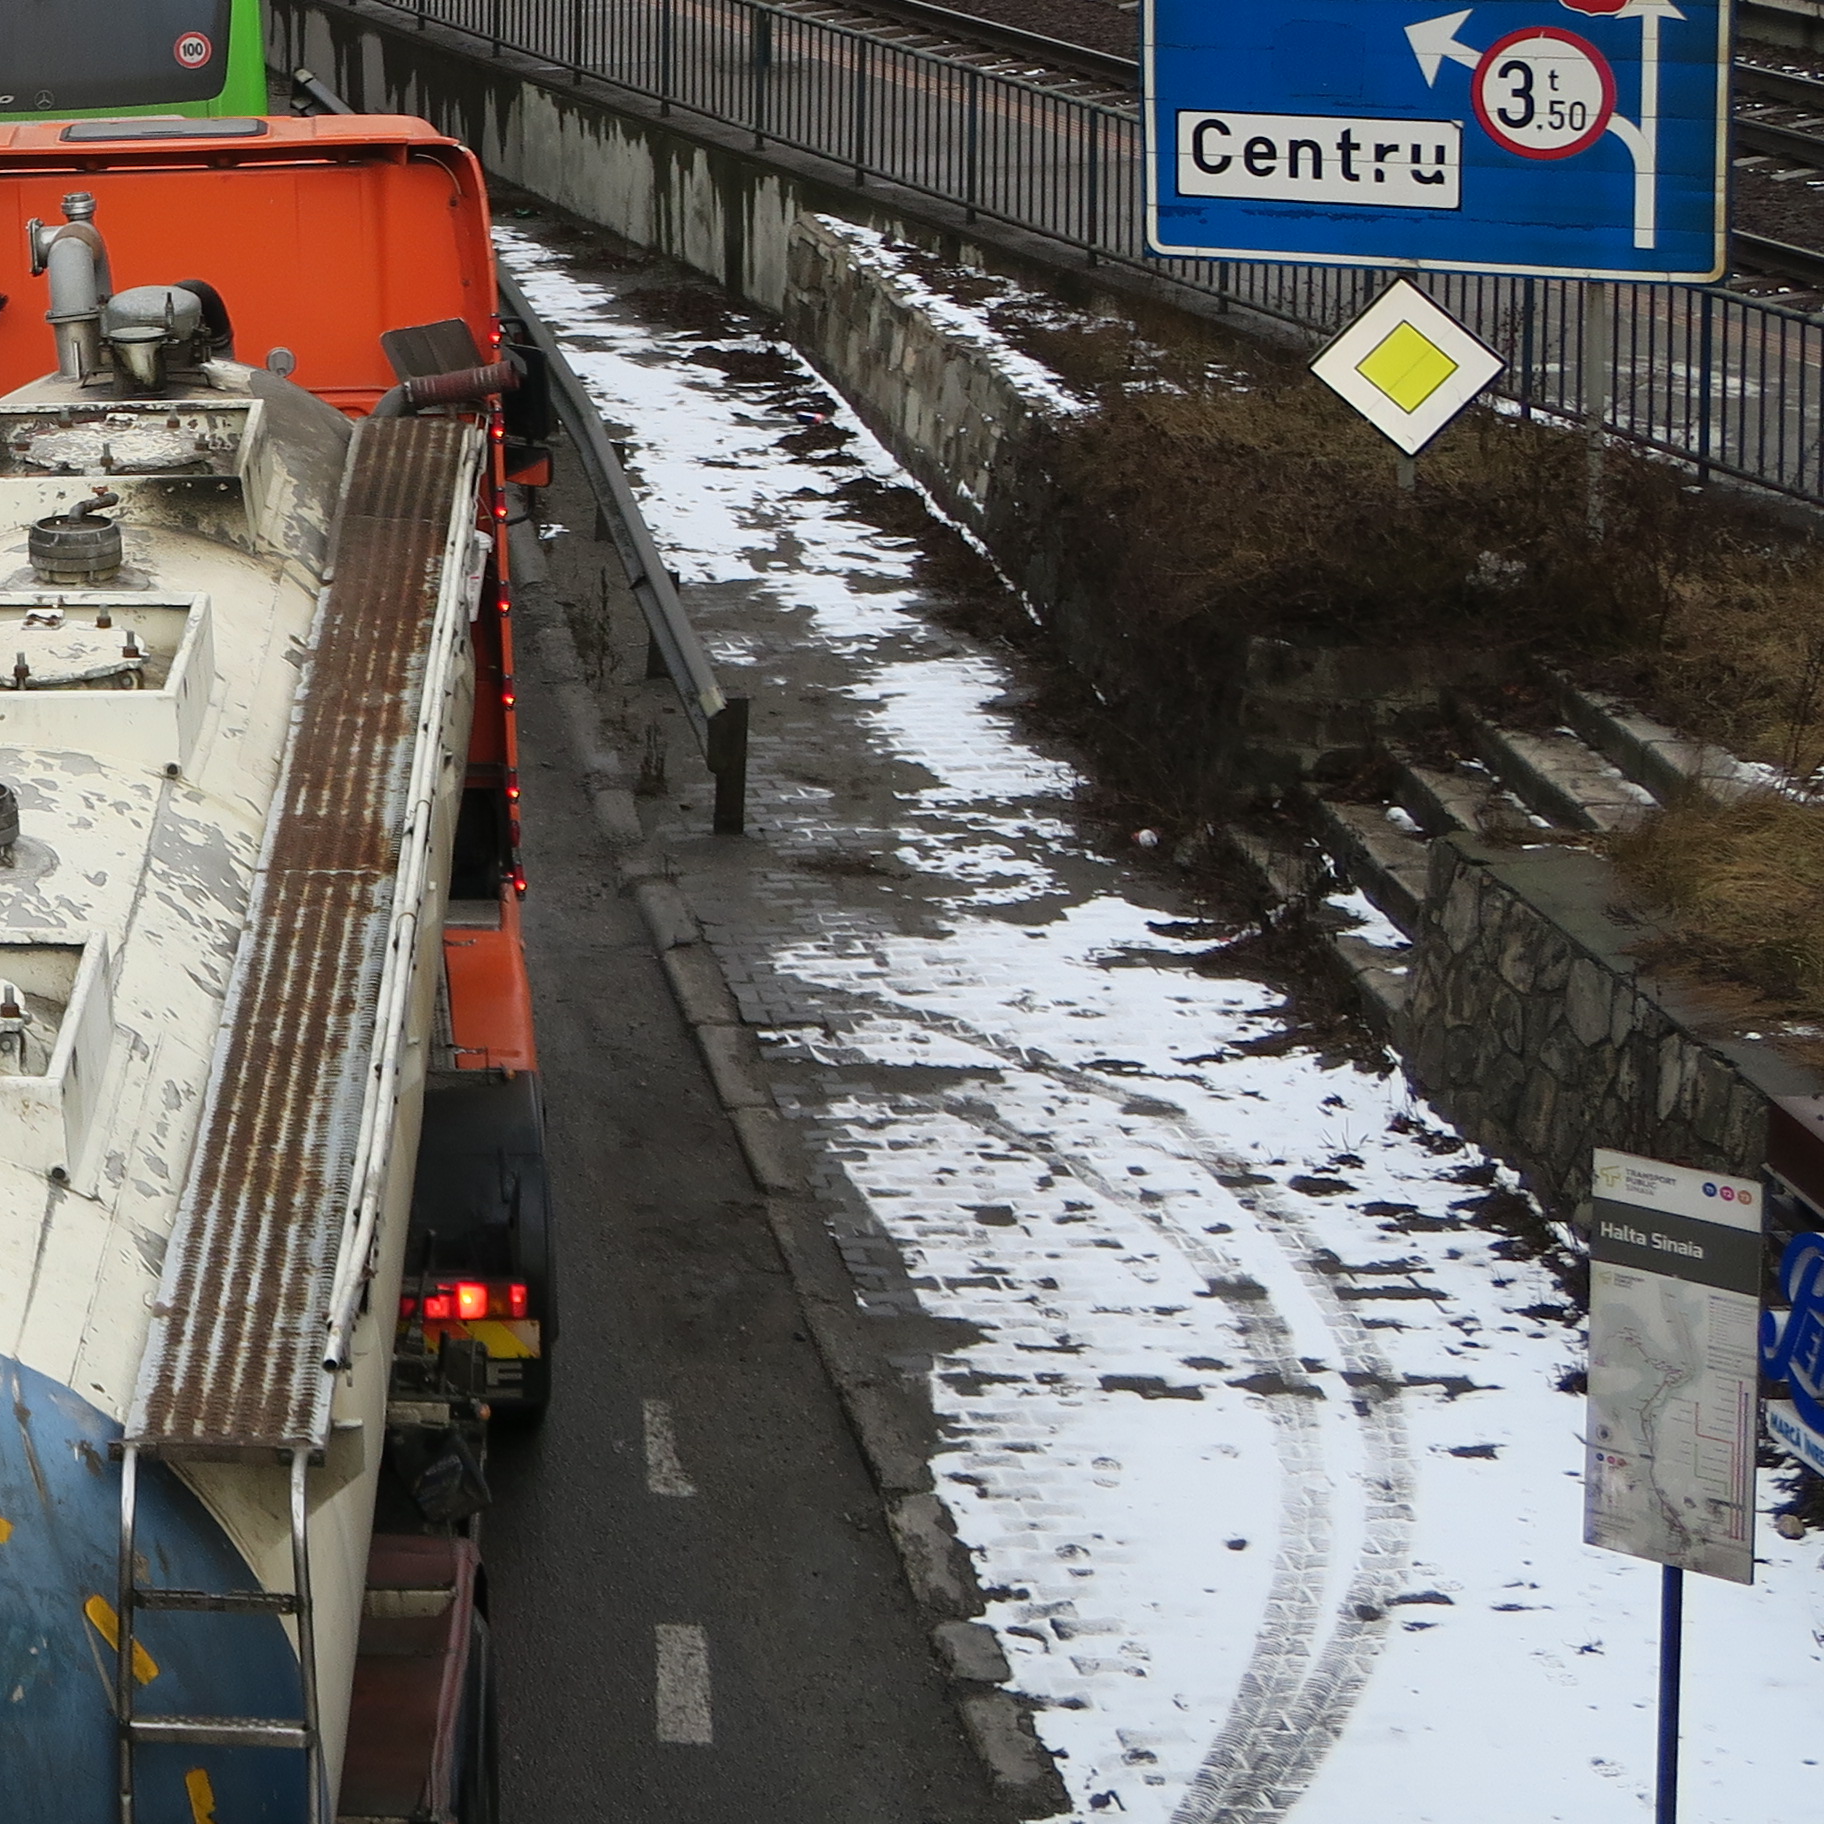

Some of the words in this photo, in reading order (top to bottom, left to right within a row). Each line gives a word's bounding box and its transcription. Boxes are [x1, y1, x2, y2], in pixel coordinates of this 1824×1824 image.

[182, 42, 204, 56] 100
[1191, 119, 1447, 186] Centru
[1625, 1168, 1677, 1186] TRANSPORT
[1625, 1177, 1657, 1190] PUBLIC
[1600, 1221, 1647, 1246] Halta
[1651, 1232, 1704, 1259] Sinaia
